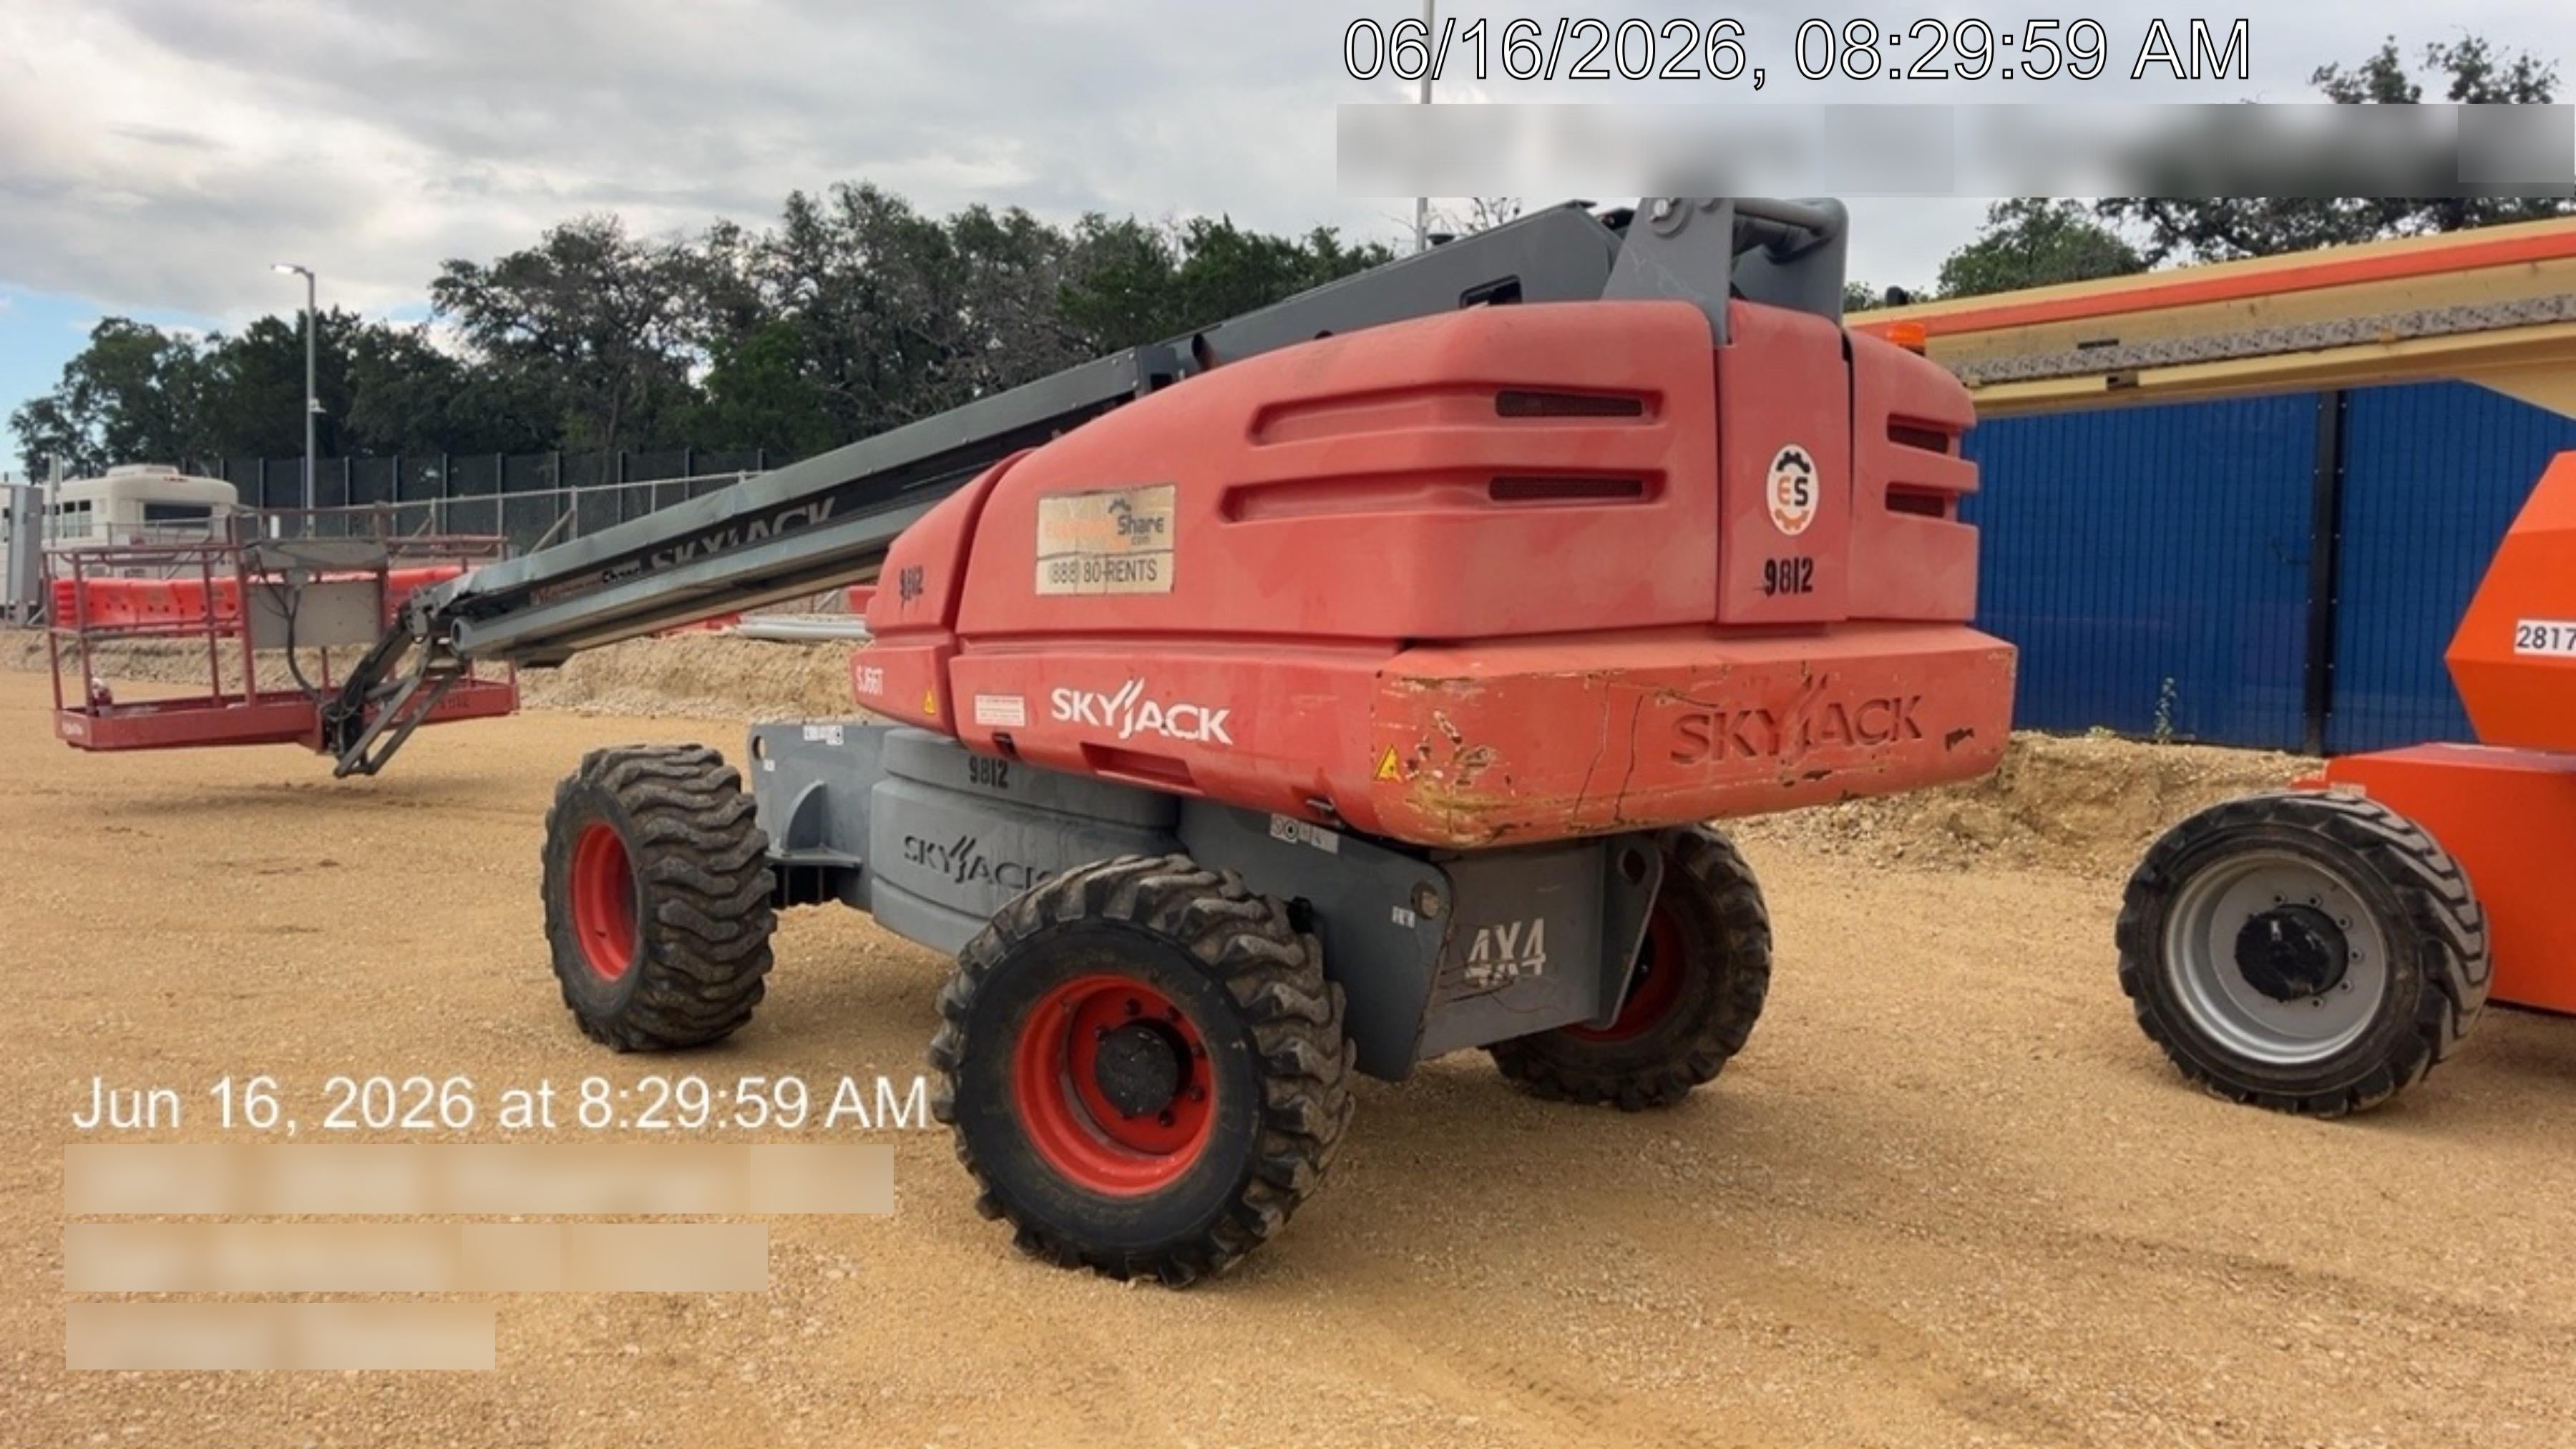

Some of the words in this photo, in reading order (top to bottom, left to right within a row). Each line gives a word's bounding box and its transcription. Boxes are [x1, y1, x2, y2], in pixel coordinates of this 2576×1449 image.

[1117, 514, 1164, 535] Share
[1764, 557, 1814, 597] 9812
[1050, 677, 1234, 746] SKYJACK
[1670, 673, 1923, 766] SKYJACK
[969, 755, 1010, 791] 9812
[1464, 918, 1546, 988] 4X4
